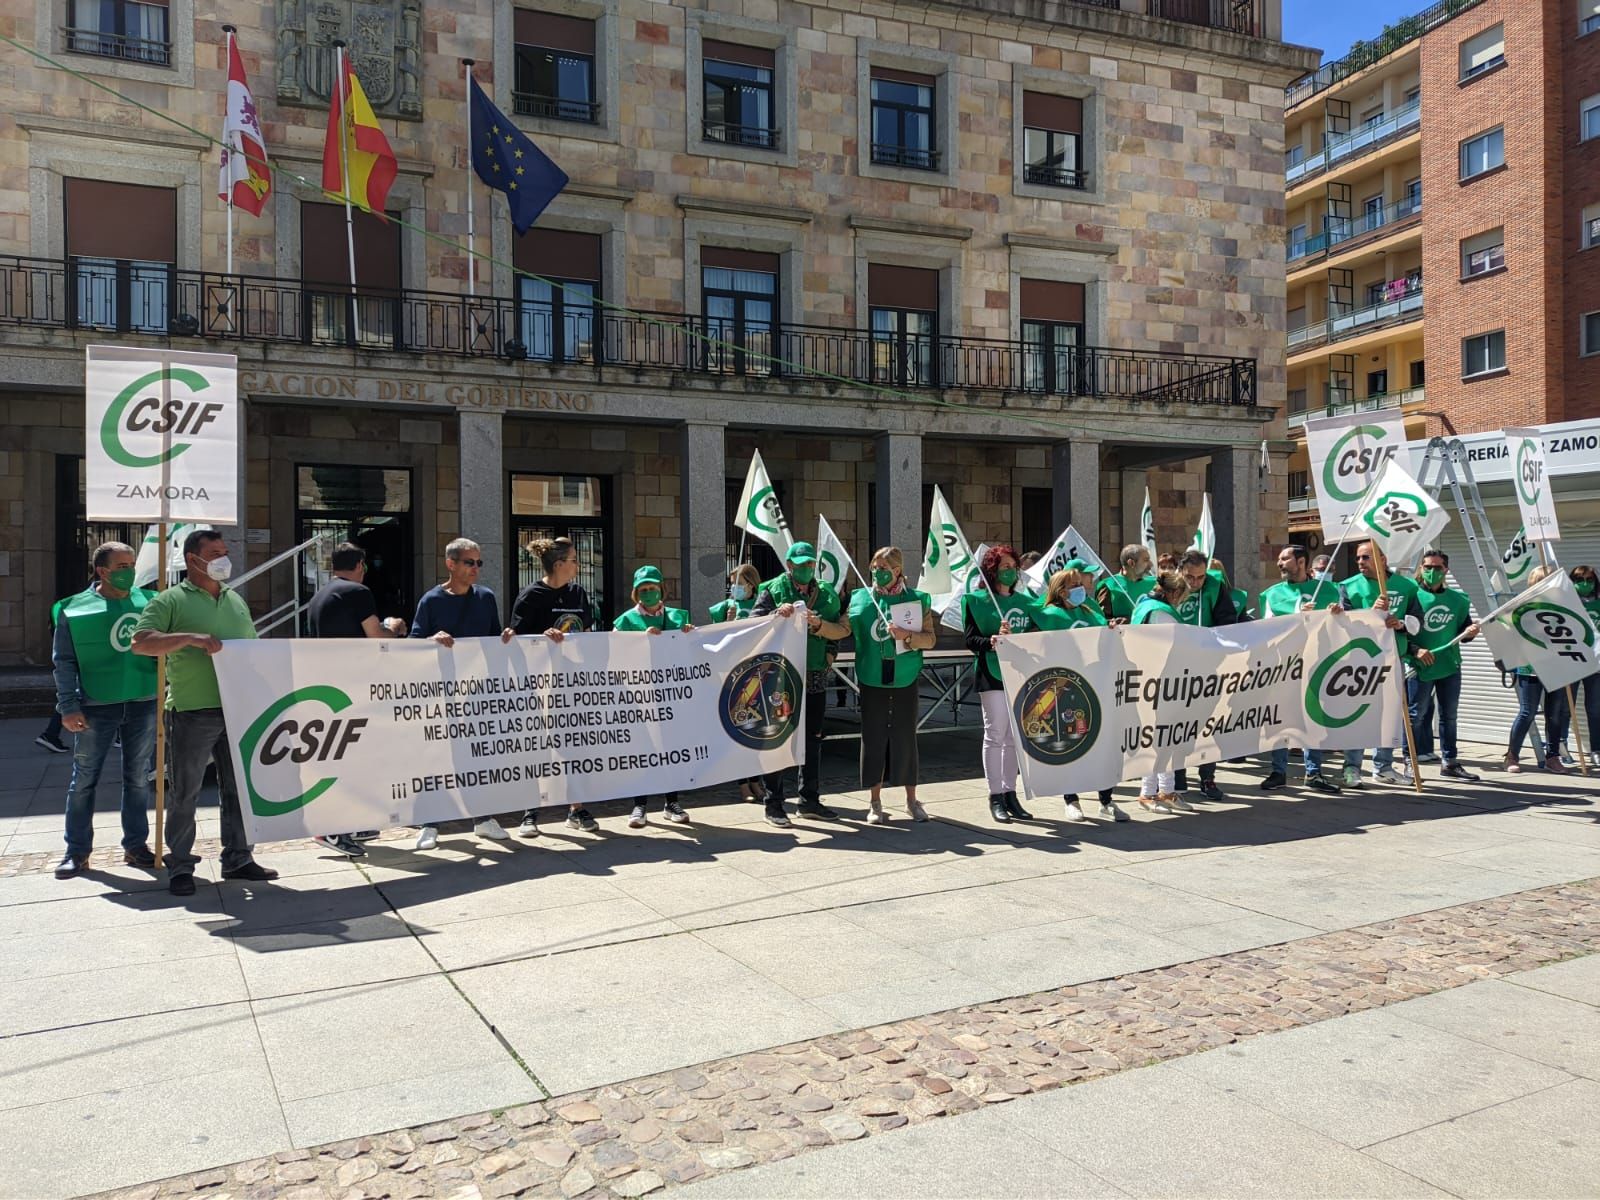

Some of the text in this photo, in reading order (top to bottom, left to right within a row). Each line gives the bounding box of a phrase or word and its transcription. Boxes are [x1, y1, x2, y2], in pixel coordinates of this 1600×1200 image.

[237, 372, 594, 411] GACION DEL GOBIERNO
[126, 397, 224, 435] CSIF
[1452, 443, 1510, 463] RERÍA
[1549, 435, 1600, 453] ZAMO
[1522, 460, 1543, 483] CSIF
[116, 484, 210, 501] ZAMORA
[1387, 595, 1404, 608] SIF
[118, 624, 136, 639] CS
[1009, 616, 1030, 628] CSIF
[1429, 613, 1455, 624] CSIF
[370, 662, 712, 701] POR LA DIGNIFICACIÓN DE LA LABOR DE LAS/LOS EMPLEADOS PÚBLICOS
[1114, 653, 1304, 710] #EquiparacionYa
[1325, 665, 1392, 697] CSIF
[394, 685, 693, 721] POR LA RECUPERACIÓN DEL PODER ADQUISITIVO
[424, 706, 674, 741] MEJORA DE LAS CONDICIONES LABORALES
[1121, 703, 1282, 753] JUSTICIA SALARIAL
[259, 718, 369, 766] CSIF
[471, 729, 631, 758] MEJORA DE LAS PENSIONES
[391, 745, 709, 800] ¡¡¡ DEFENDEMOS NUESTROS DERECHOS !!!
